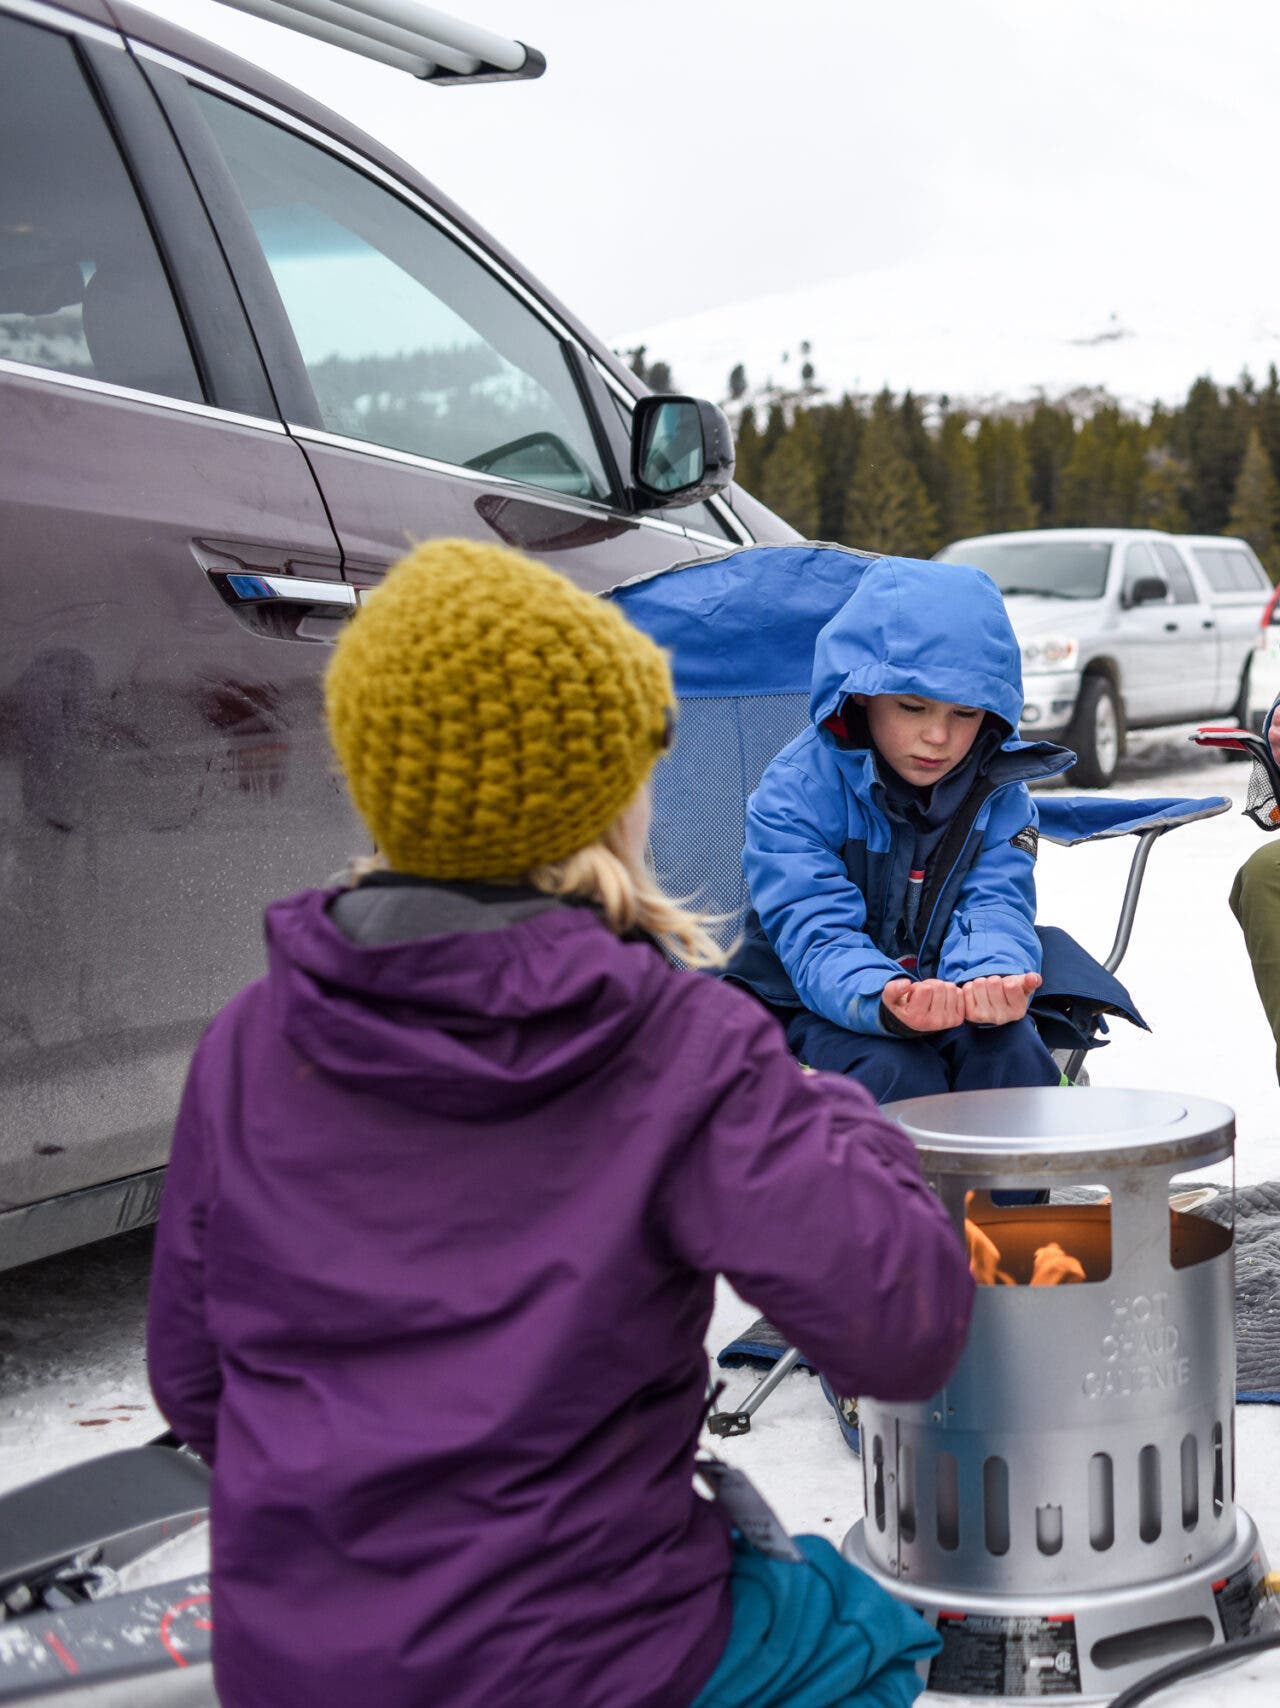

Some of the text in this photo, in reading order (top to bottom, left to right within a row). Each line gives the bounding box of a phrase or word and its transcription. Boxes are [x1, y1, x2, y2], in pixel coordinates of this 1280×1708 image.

[1108, 1291, 1169, 1323] HOT
[1101, 1323, 1179, 1361] CHAUD
[1082, 1357, 1191, 1399] CALIENTE
